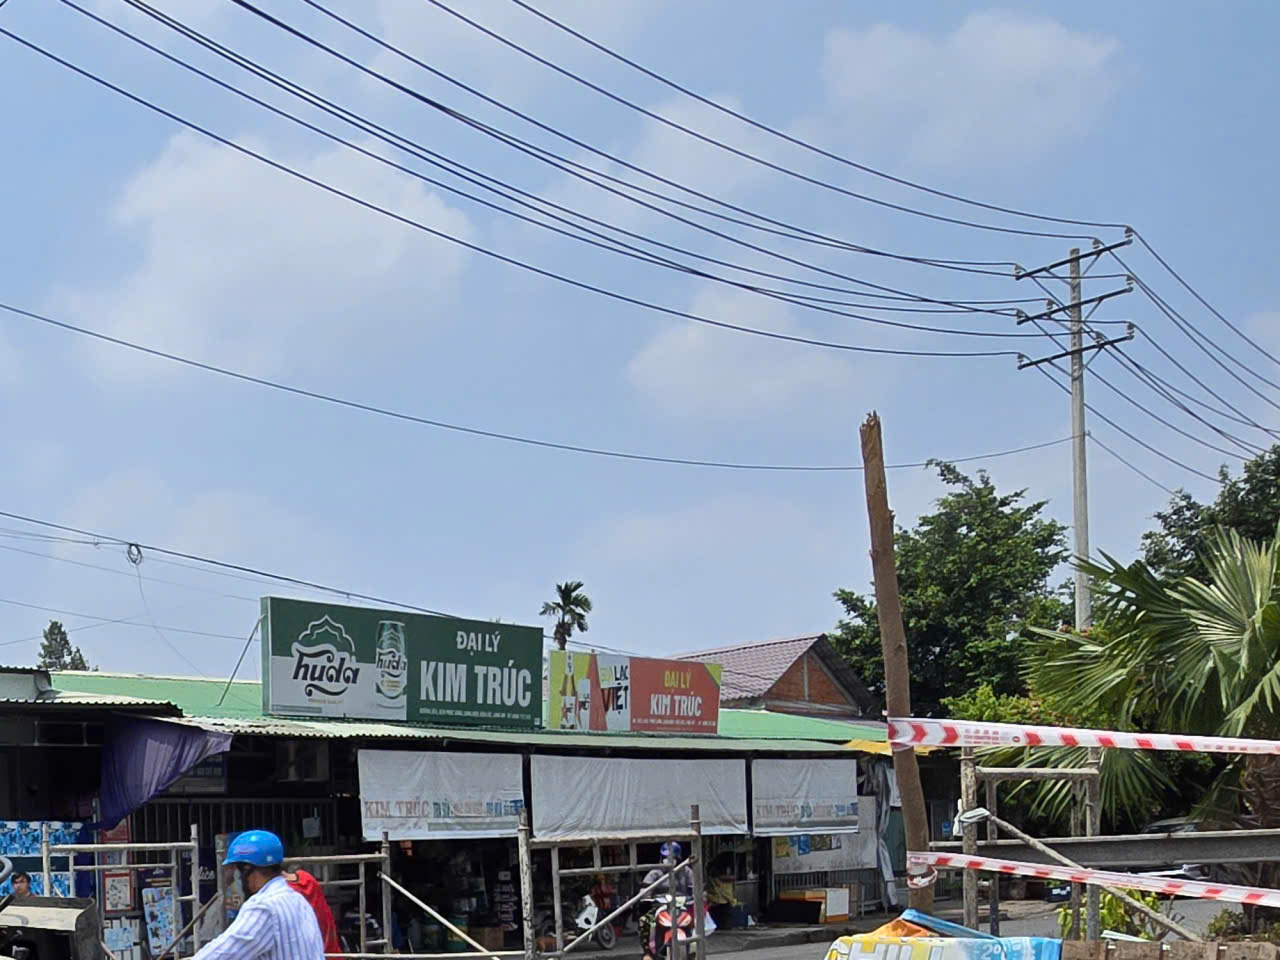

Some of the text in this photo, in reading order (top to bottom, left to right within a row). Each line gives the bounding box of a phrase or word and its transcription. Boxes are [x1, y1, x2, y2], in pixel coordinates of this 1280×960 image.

[456, 631, 501, 656] ĐẠI LÝ
[292, 648, 360, 684] huda
[420, 659, 531, 707] KIM TRÚC
[650, 691, 702, 716] KIM TRÚC
